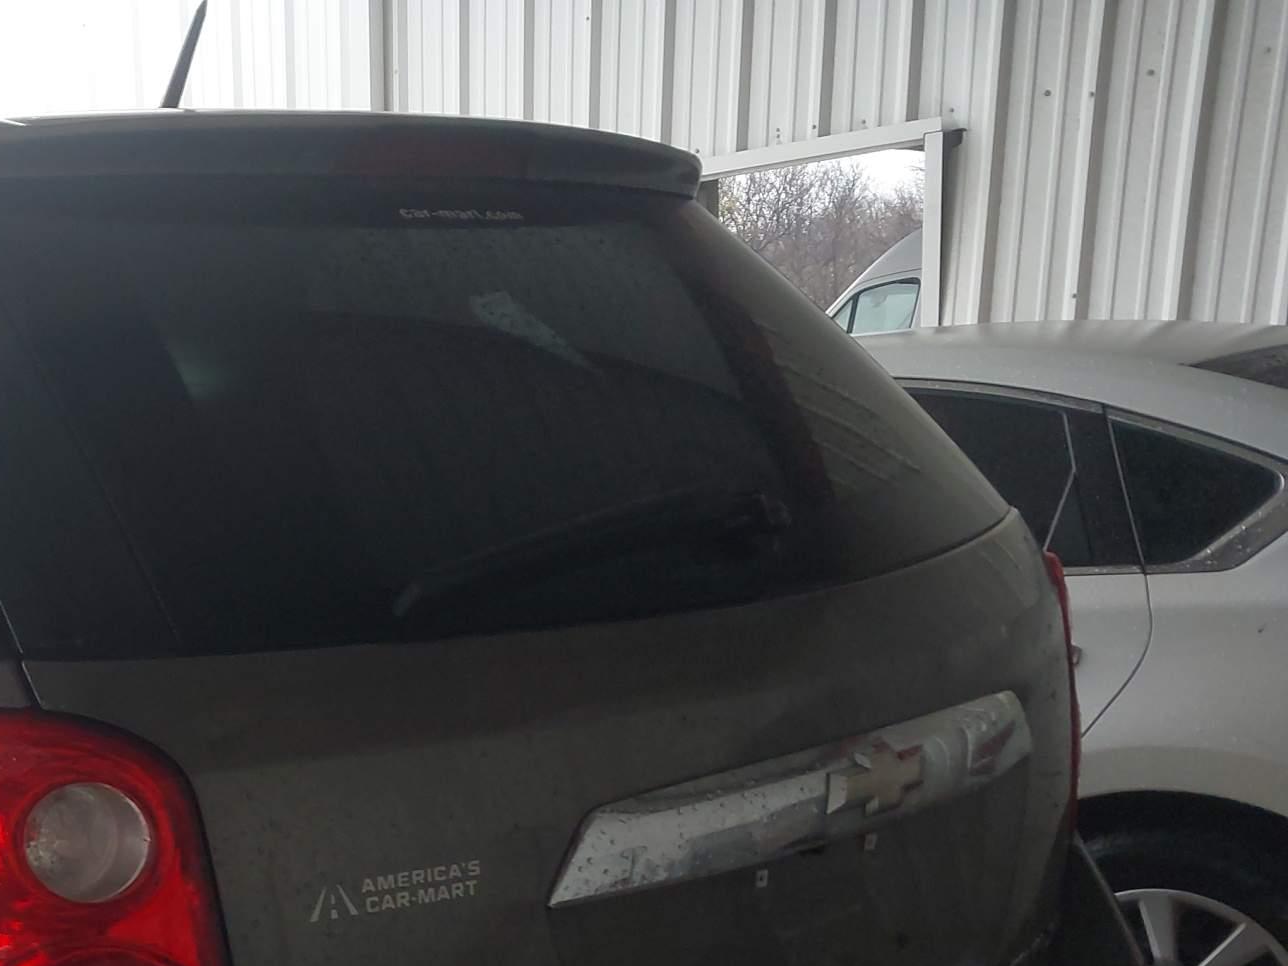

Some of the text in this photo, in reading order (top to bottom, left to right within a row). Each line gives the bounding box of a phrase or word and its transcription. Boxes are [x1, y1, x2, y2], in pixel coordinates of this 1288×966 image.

[399, 208, 524, 221] car-mart.com
[362, 860, 481, 893] AMERICA'S
[365, 880, 478, 913] CAR-MART
